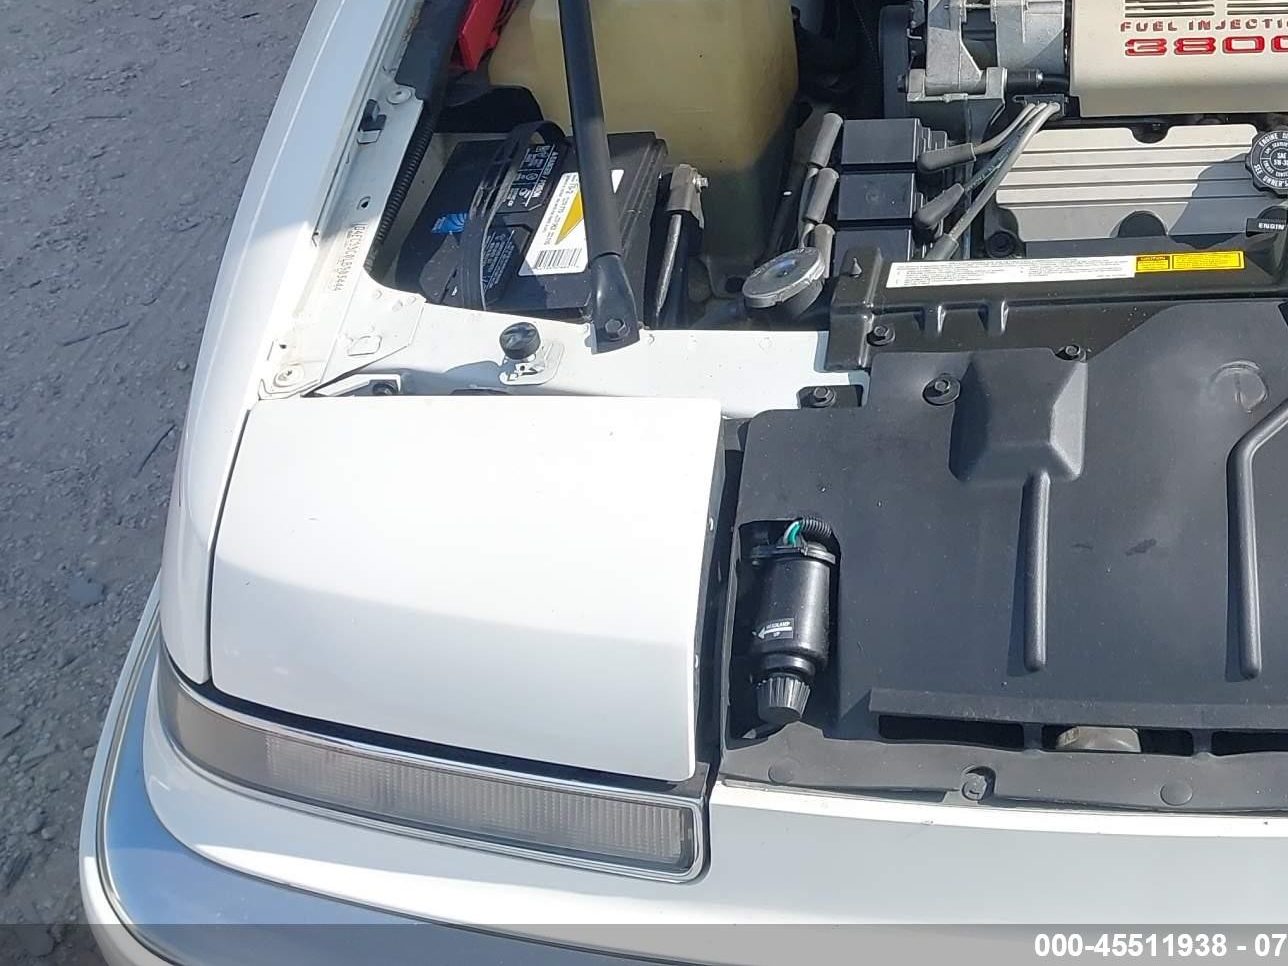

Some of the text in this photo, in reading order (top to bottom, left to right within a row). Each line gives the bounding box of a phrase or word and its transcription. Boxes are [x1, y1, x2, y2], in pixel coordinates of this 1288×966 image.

[1120, 19, 1178, 32] FUEL
[1258, 132, 1278, 146] ENGINE
[1253, 163, 1262, 174] SEE
[1262, 175, 1288, 186] OWNER'S
[1258, 222, 1285, 230] ENGIN
